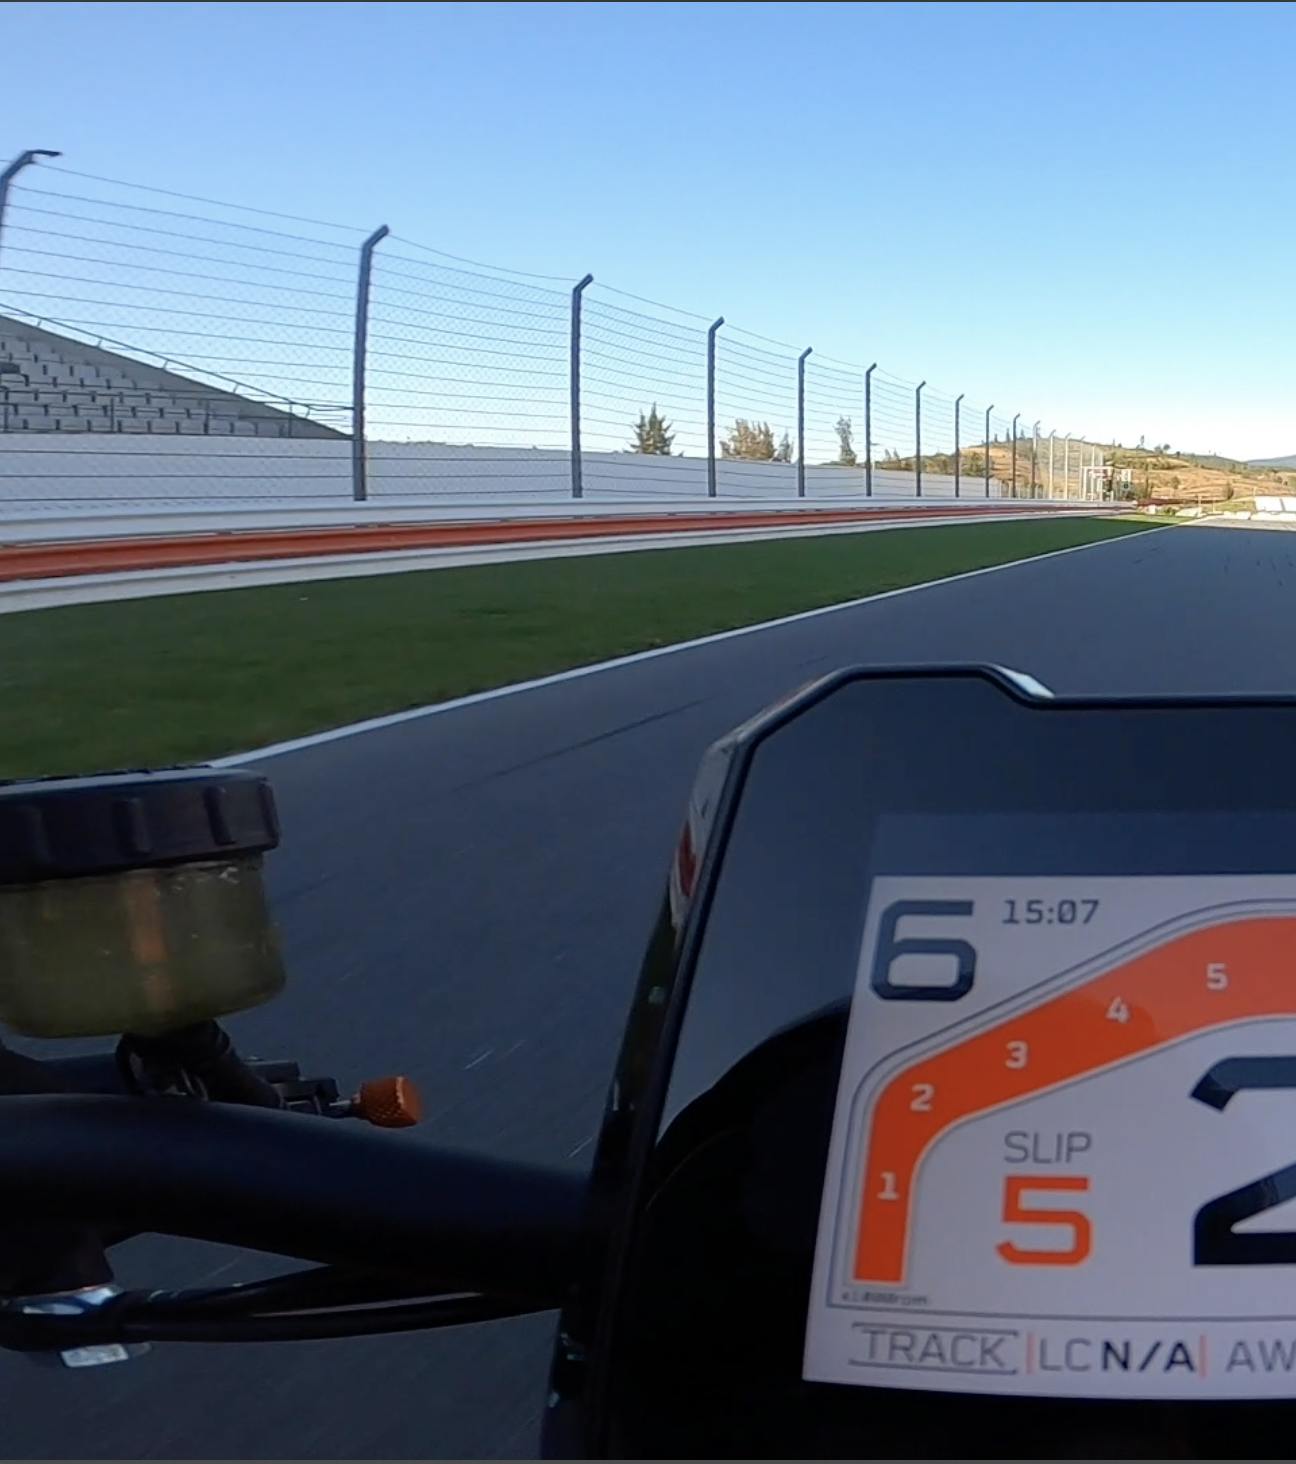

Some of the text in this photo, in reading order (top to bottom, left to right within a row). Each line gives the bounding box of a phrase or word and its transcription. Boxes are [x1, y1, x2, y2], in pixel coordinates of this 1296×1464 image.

[1001, 899, 1099, 926] 15:07
[870, 900, 977, 1002] 6
[877, 1172, 898, 1200] 1
[910, 1084, 935, 1111] 2
[1005, 1041, 1029, 1068] 3
[1106, 997, 1130, 1024] 4
[1206, 962, 1228, 990] 5
[1003, 1131, 1091, 1164] SLIP
[996, 1175, 1093, 1267] 5
[862, 1328, 1006, 1368] TRACK
[1039, 1338, 1197, 1372] LC N/A
